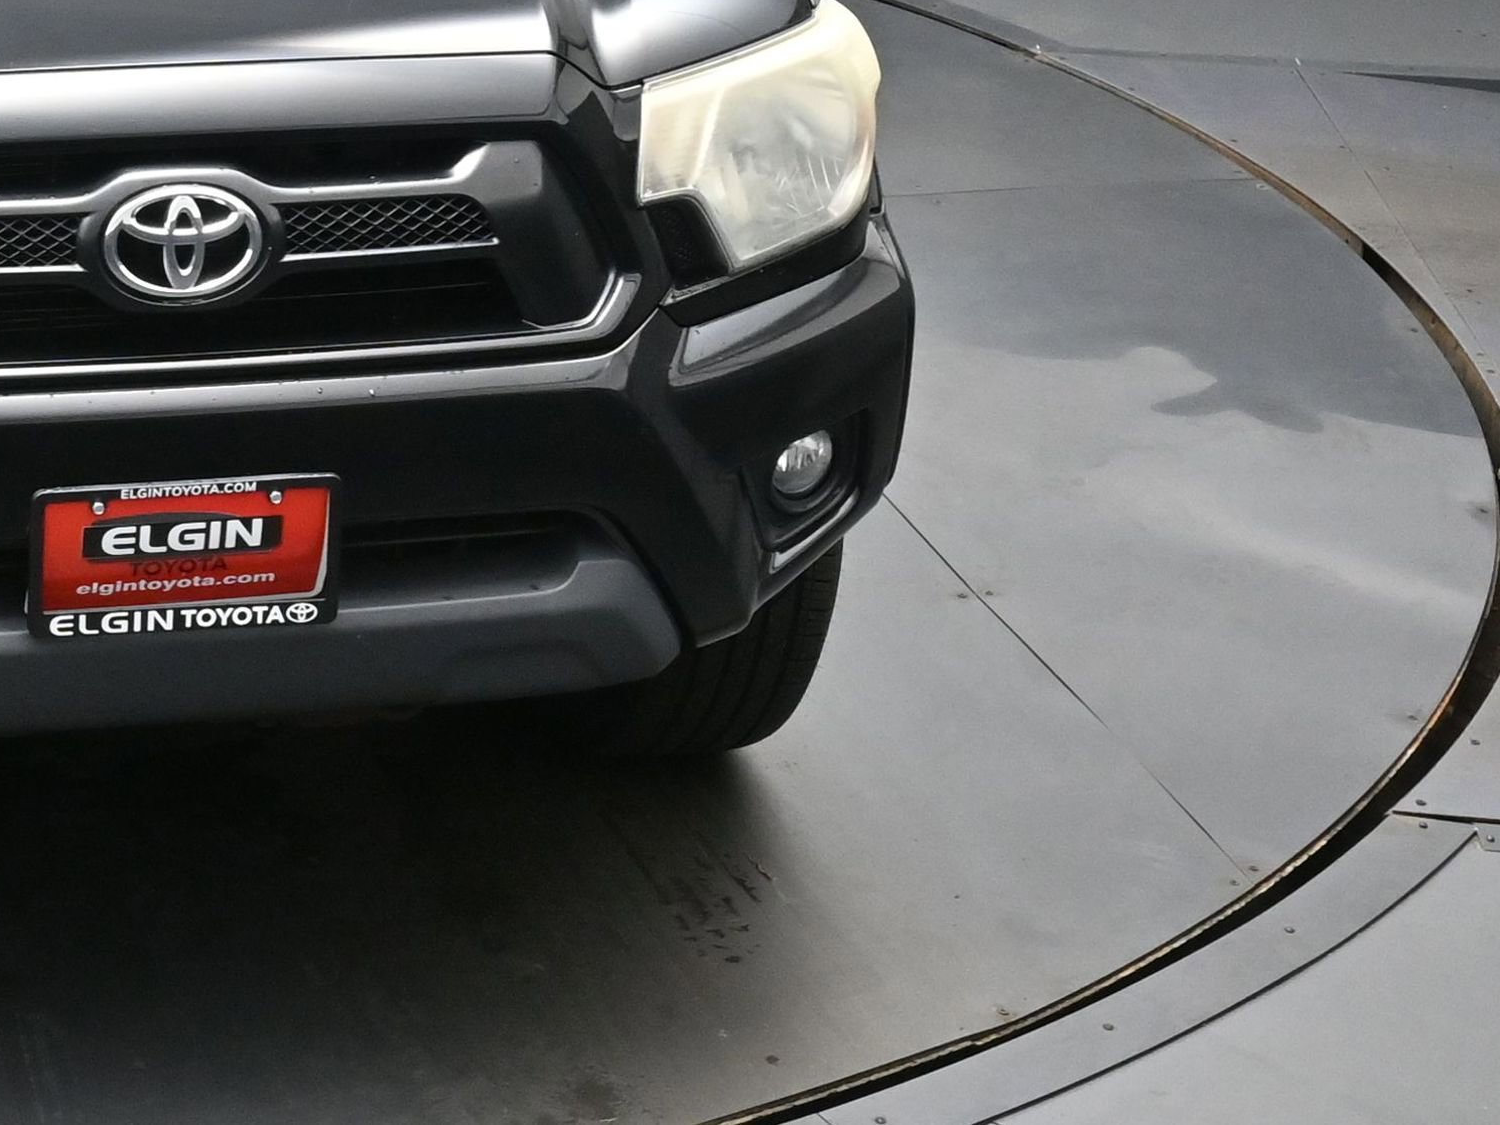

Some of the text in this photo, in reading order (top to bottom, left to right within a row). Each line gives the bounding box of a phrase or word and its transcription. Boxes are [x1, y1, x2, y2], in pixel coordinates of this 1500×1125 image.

[120, 481, 257, 500] ELGINTOYOTA.COM
[101, 518, 263, 555] ELGIN
[130, 557, 228, 576] TOYOTA
[76, 572, 275, 595] elgintoyota.com
[49, 605, 285, 637] ELGIN TOYOTA
